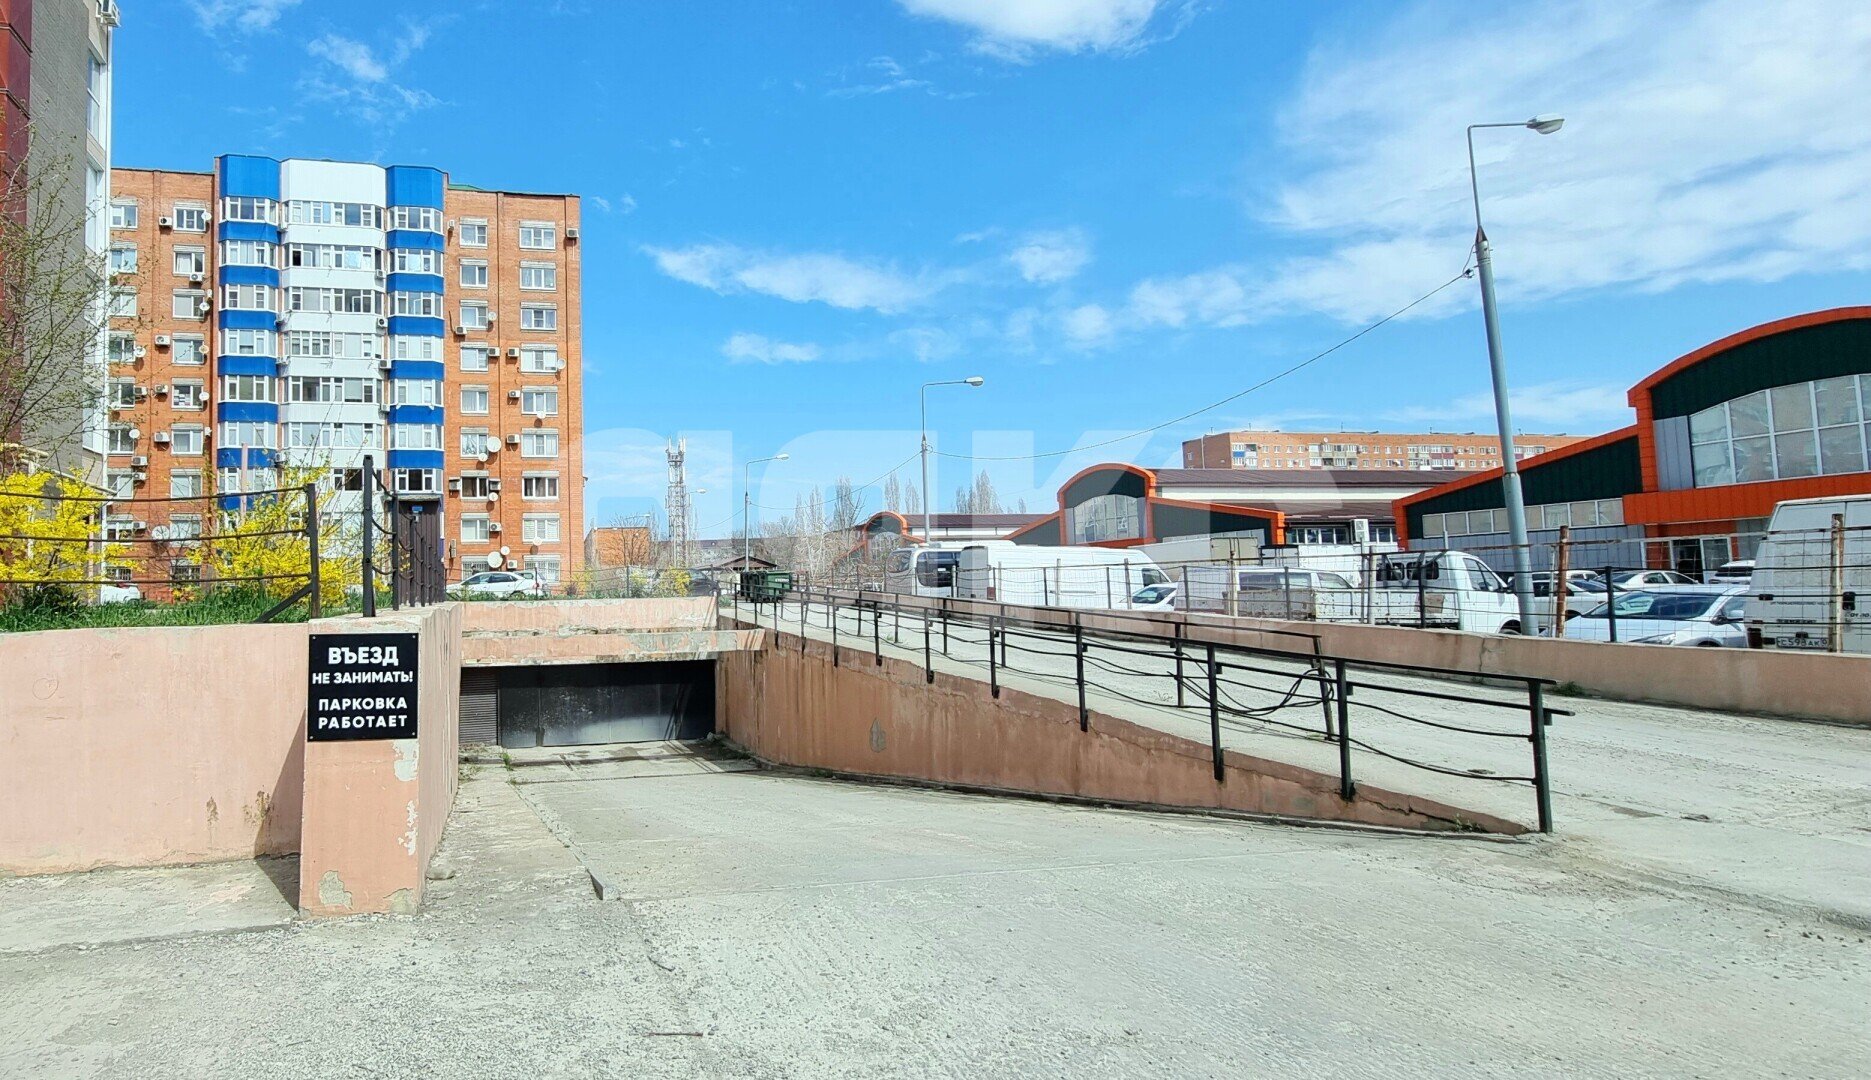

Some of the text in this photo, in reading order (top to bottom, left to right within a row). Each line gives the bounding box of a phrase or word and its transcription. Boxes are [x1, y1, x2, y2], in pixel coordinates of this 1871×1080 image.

[328, 646, 399, 667] ВЪЕЗД
[312, 671, 414, 684] НЕ ЗАНИМАТЬ!
[318, 697, 408, 711] ПАРКОВКА
[318, 715, 408, 729] РАБОТАЕТ
